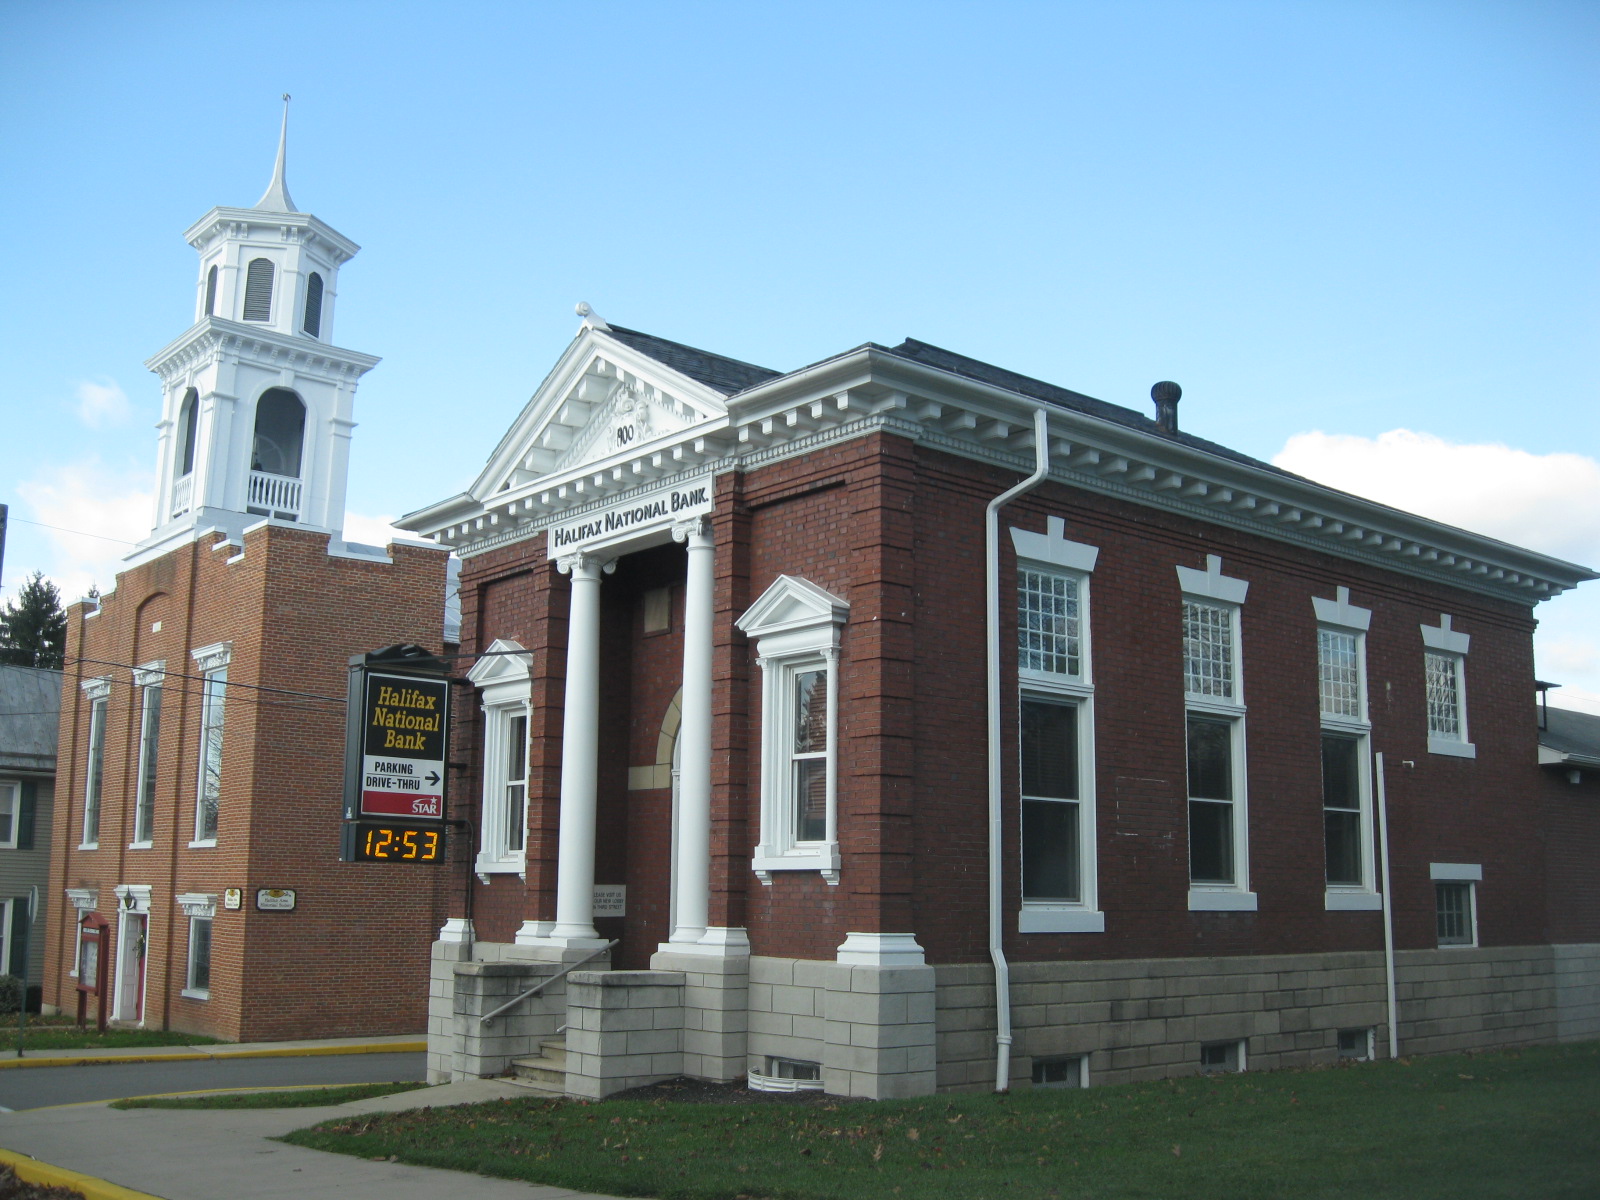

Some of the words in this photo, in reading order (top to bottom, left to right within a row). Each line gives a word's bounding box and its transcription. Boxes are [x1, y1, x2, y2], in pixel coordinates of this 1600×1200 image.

[554, 519, 602, 548] HALIFAX
[604, 500, 668, 532] NATIONAL
[377, 685, 437, 710] Halifax
[372, 707, 440, 732] National
[384, 729, 427, 750] Bank
[374, 761, 414, 775] PARKING
[366, 776, 421, 790] DRIVE-THRU
[412, 802, 437, 814] STAR
[365, 829, 438, 859] 12:53
